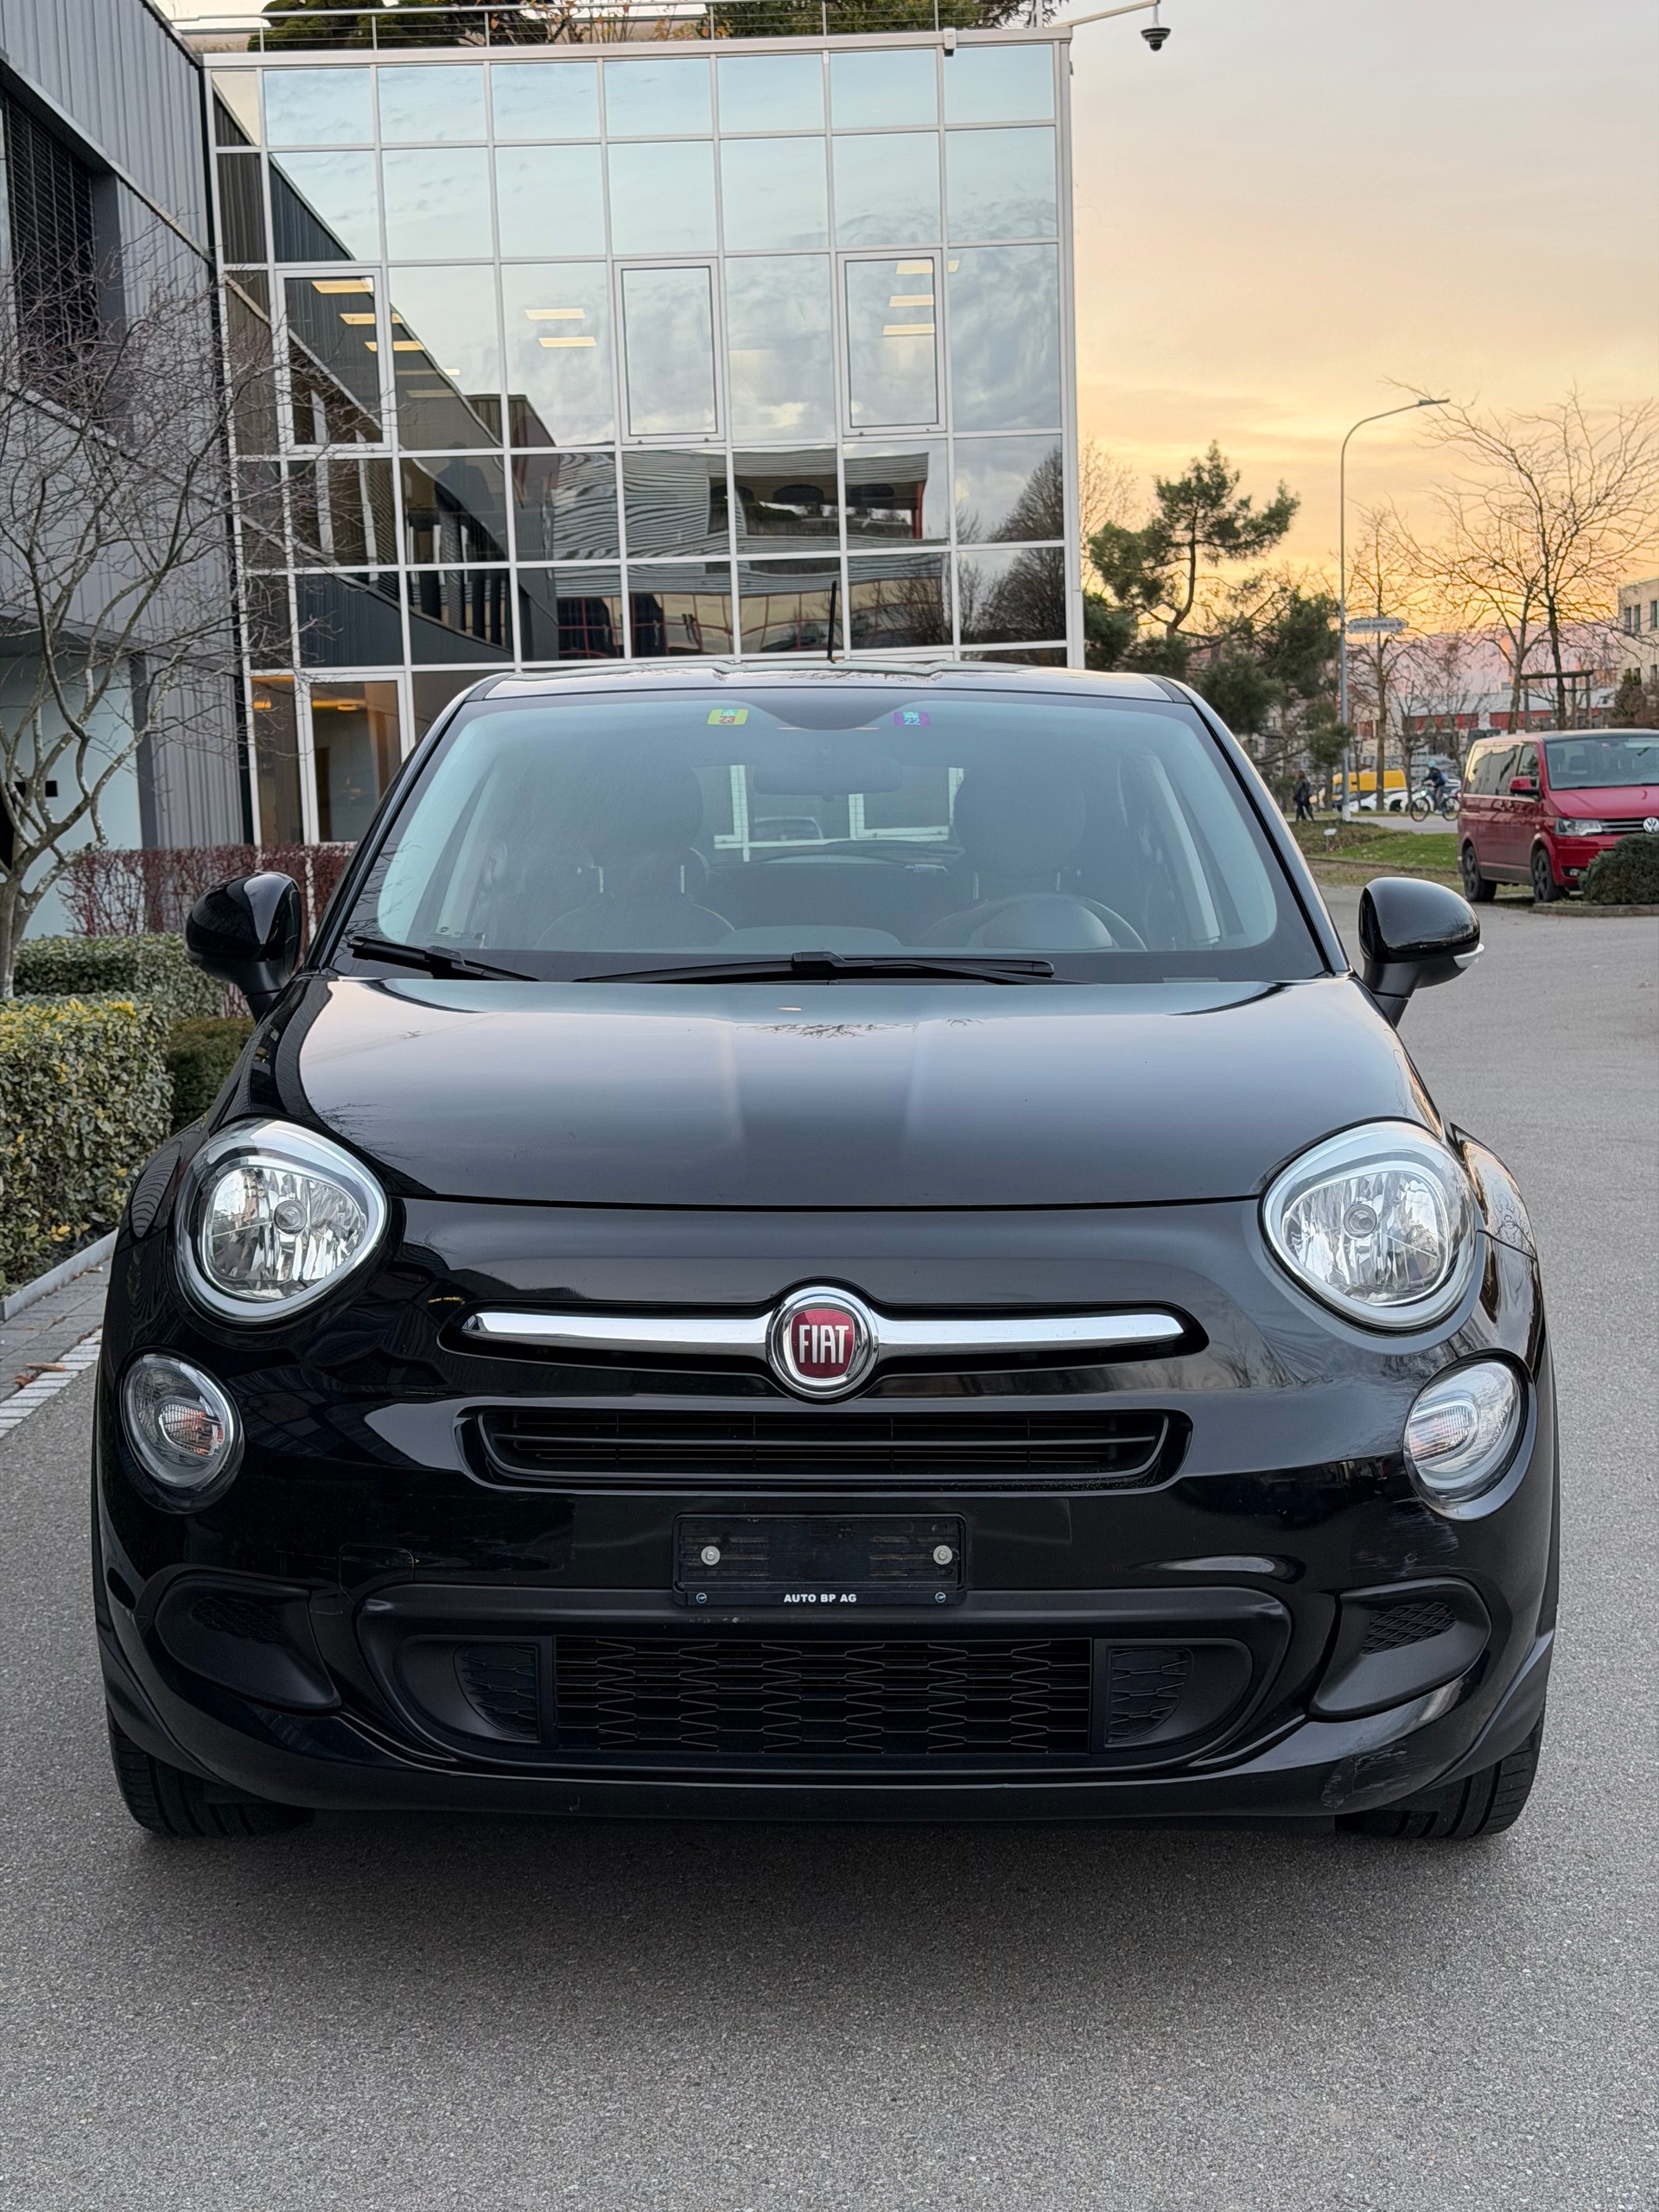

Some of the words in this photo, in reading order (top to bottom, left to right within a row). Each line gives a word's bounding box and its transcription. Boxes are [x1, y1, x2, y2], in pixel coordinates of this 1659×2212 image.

[799, 1325, 849, 1363] FIAT
[784, 1593, 817, 1603] AUTO
[820, 1593, 836, 1603] BP
[839, 1593, 857, 1603] AG
